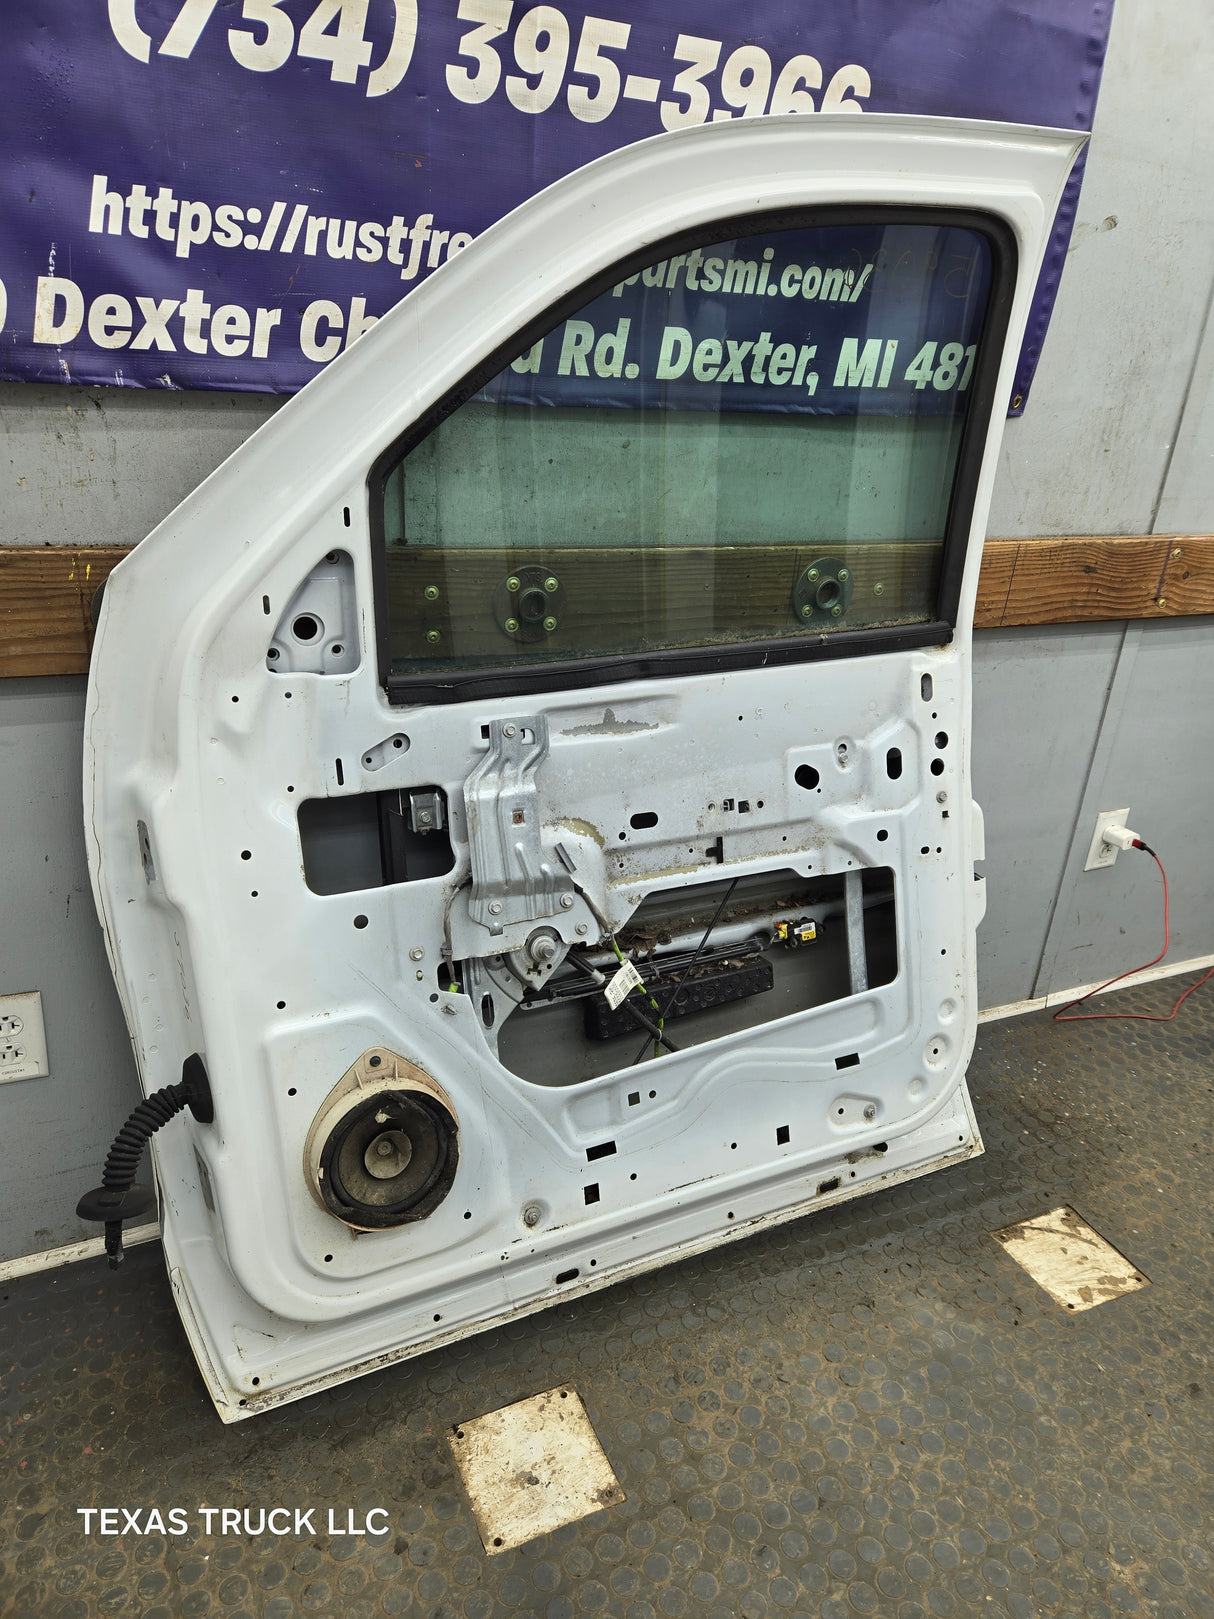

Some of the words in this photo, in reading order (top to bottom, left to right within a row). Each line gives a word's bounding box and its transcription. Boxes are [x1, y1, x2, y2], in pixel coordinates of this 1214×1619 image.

[33, 276, 282, 359] Dexter
[557, 317, 640, 379] Rd.
[656, 326, 819, 396] Dexter,
[833, 337, 899, 388] MI
